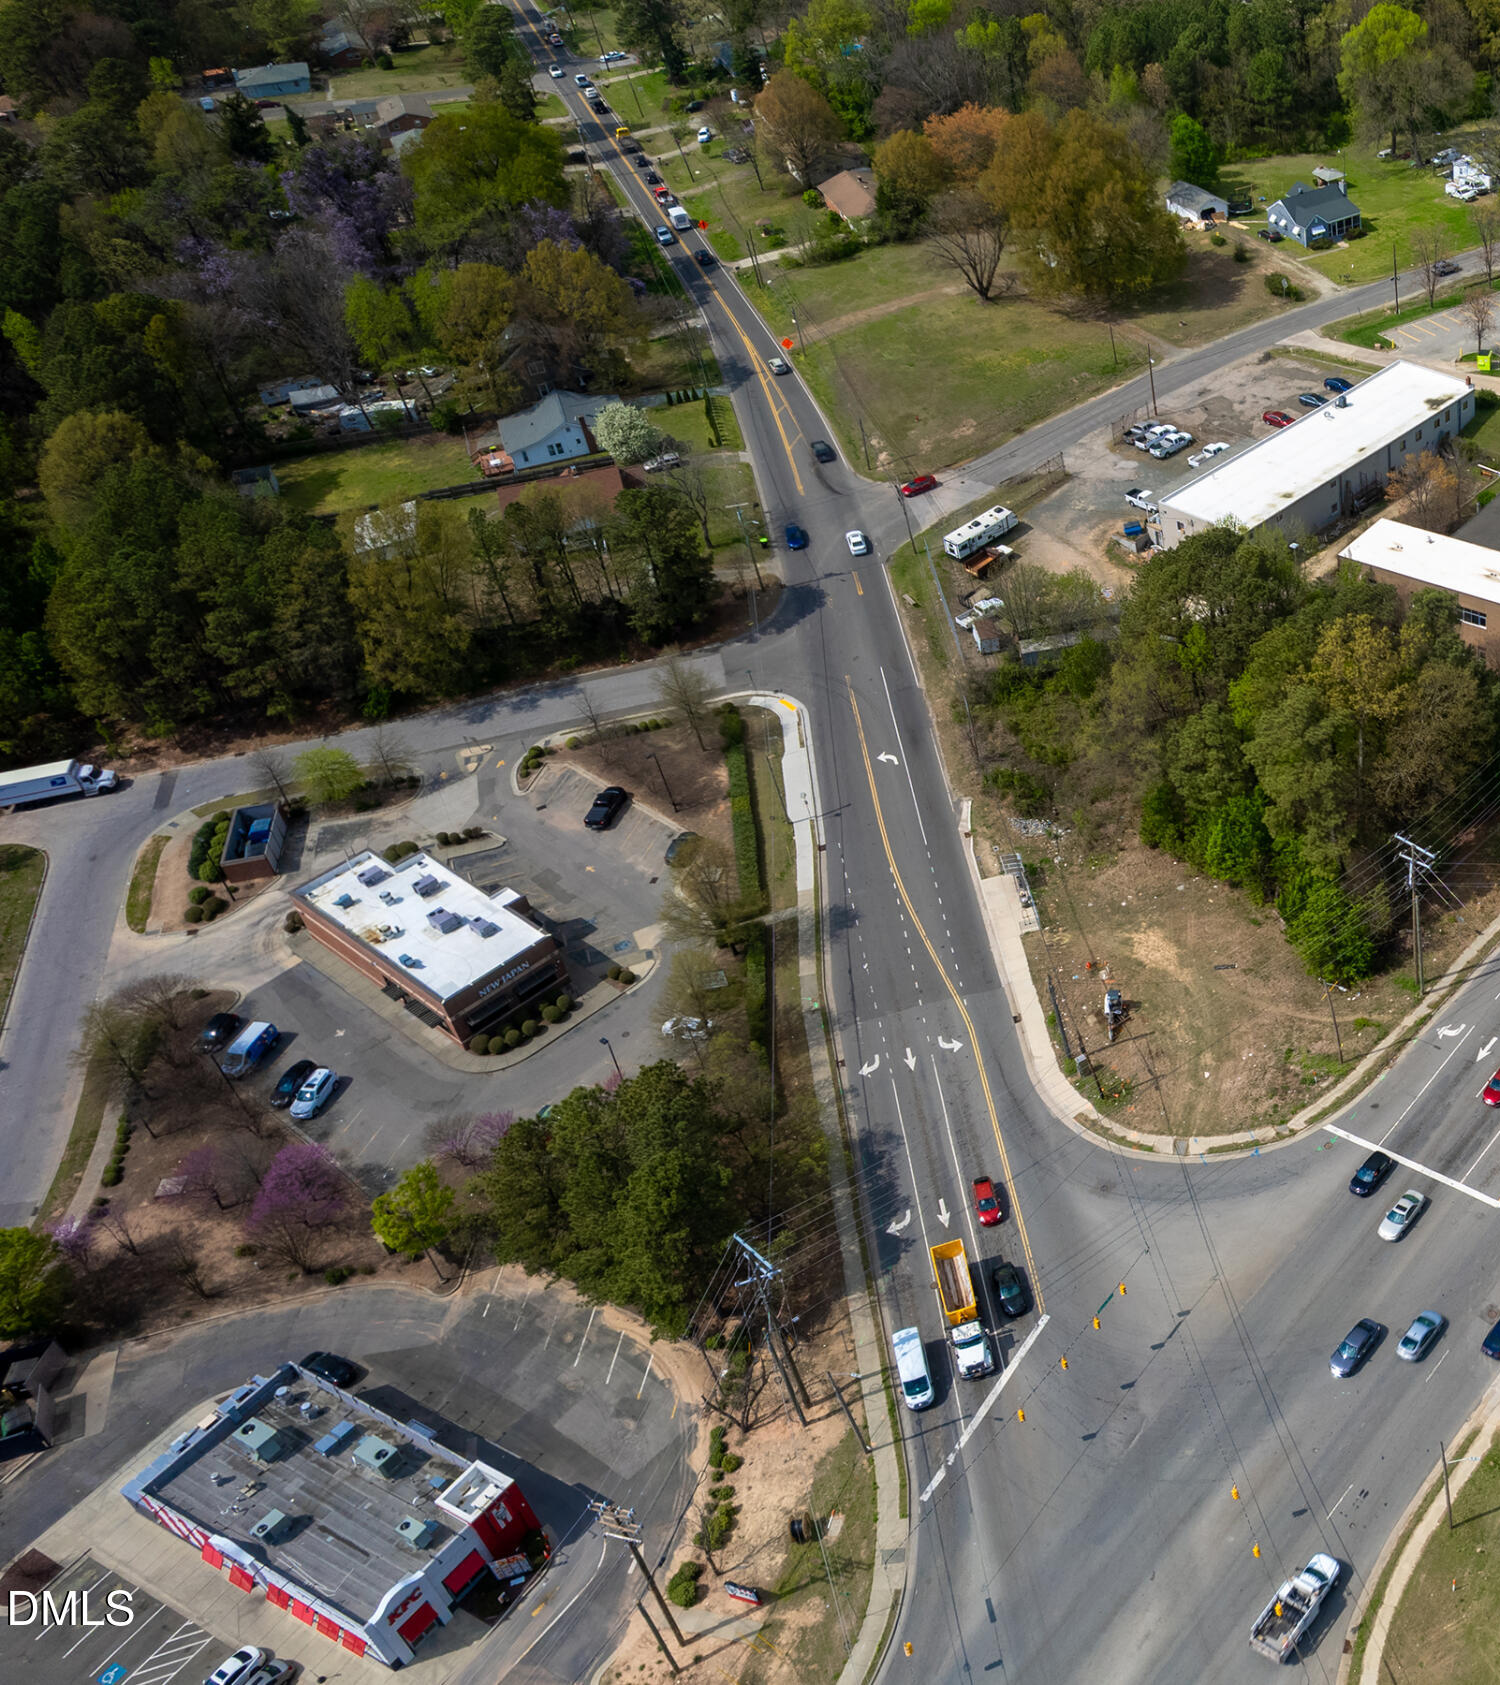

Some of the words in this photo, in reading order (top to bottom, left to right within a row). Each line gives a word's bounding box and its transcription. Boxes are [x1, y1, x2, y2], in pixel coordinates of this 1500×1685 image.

[478, 979, 500, 998] NEW
[501, 960, 530, 984] JAPAN
[387, 1586, 423, 1627] KFC
